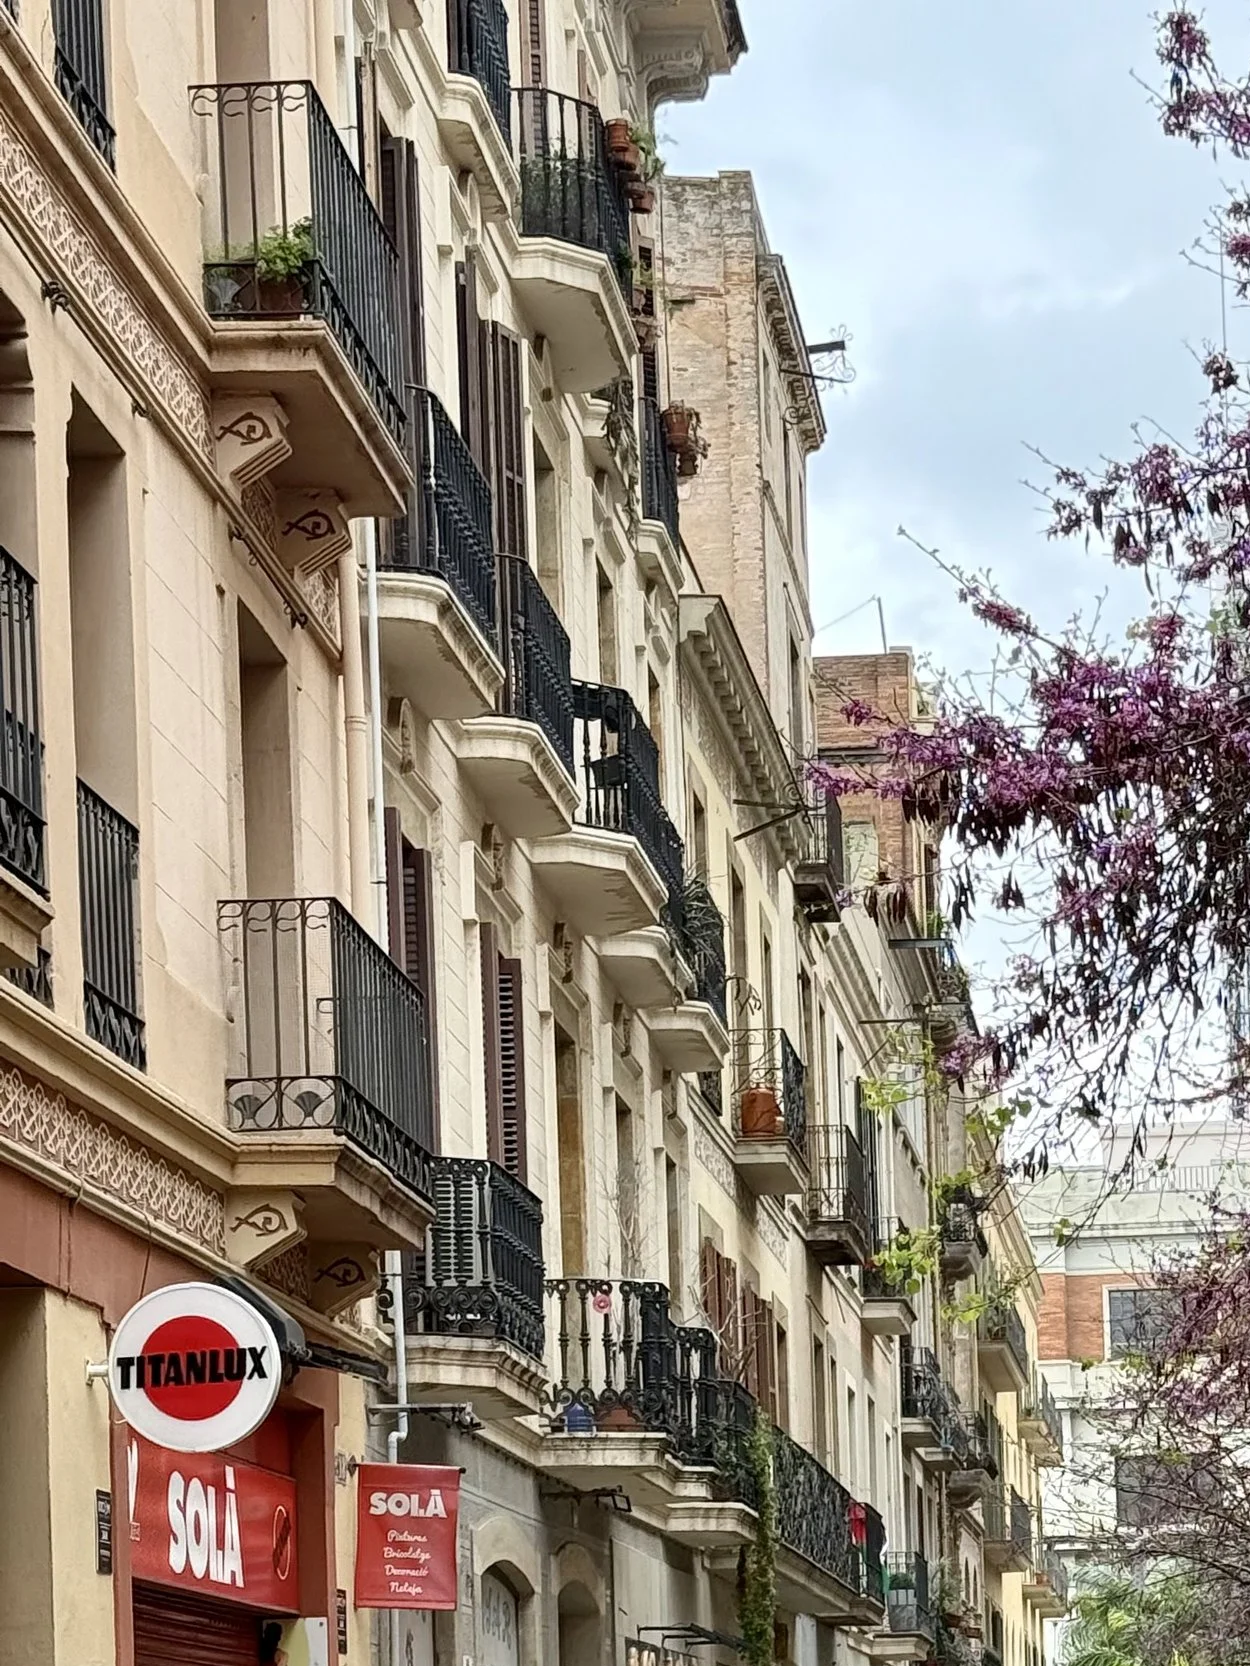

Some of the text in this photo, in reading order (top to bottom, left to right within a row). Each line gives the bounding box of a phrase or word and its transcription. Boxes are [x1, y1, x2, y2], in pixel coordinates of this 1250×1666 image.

[116, 1345, 268, 1390] TITANLUX
[369, 1489, 448, 1518] SOLÀ
[167, 1464, 245, 1588] SOLÀ
[383, 1547, 431, 1564] Bricolatge
[389, 1581, 423, 1596] Neteja
